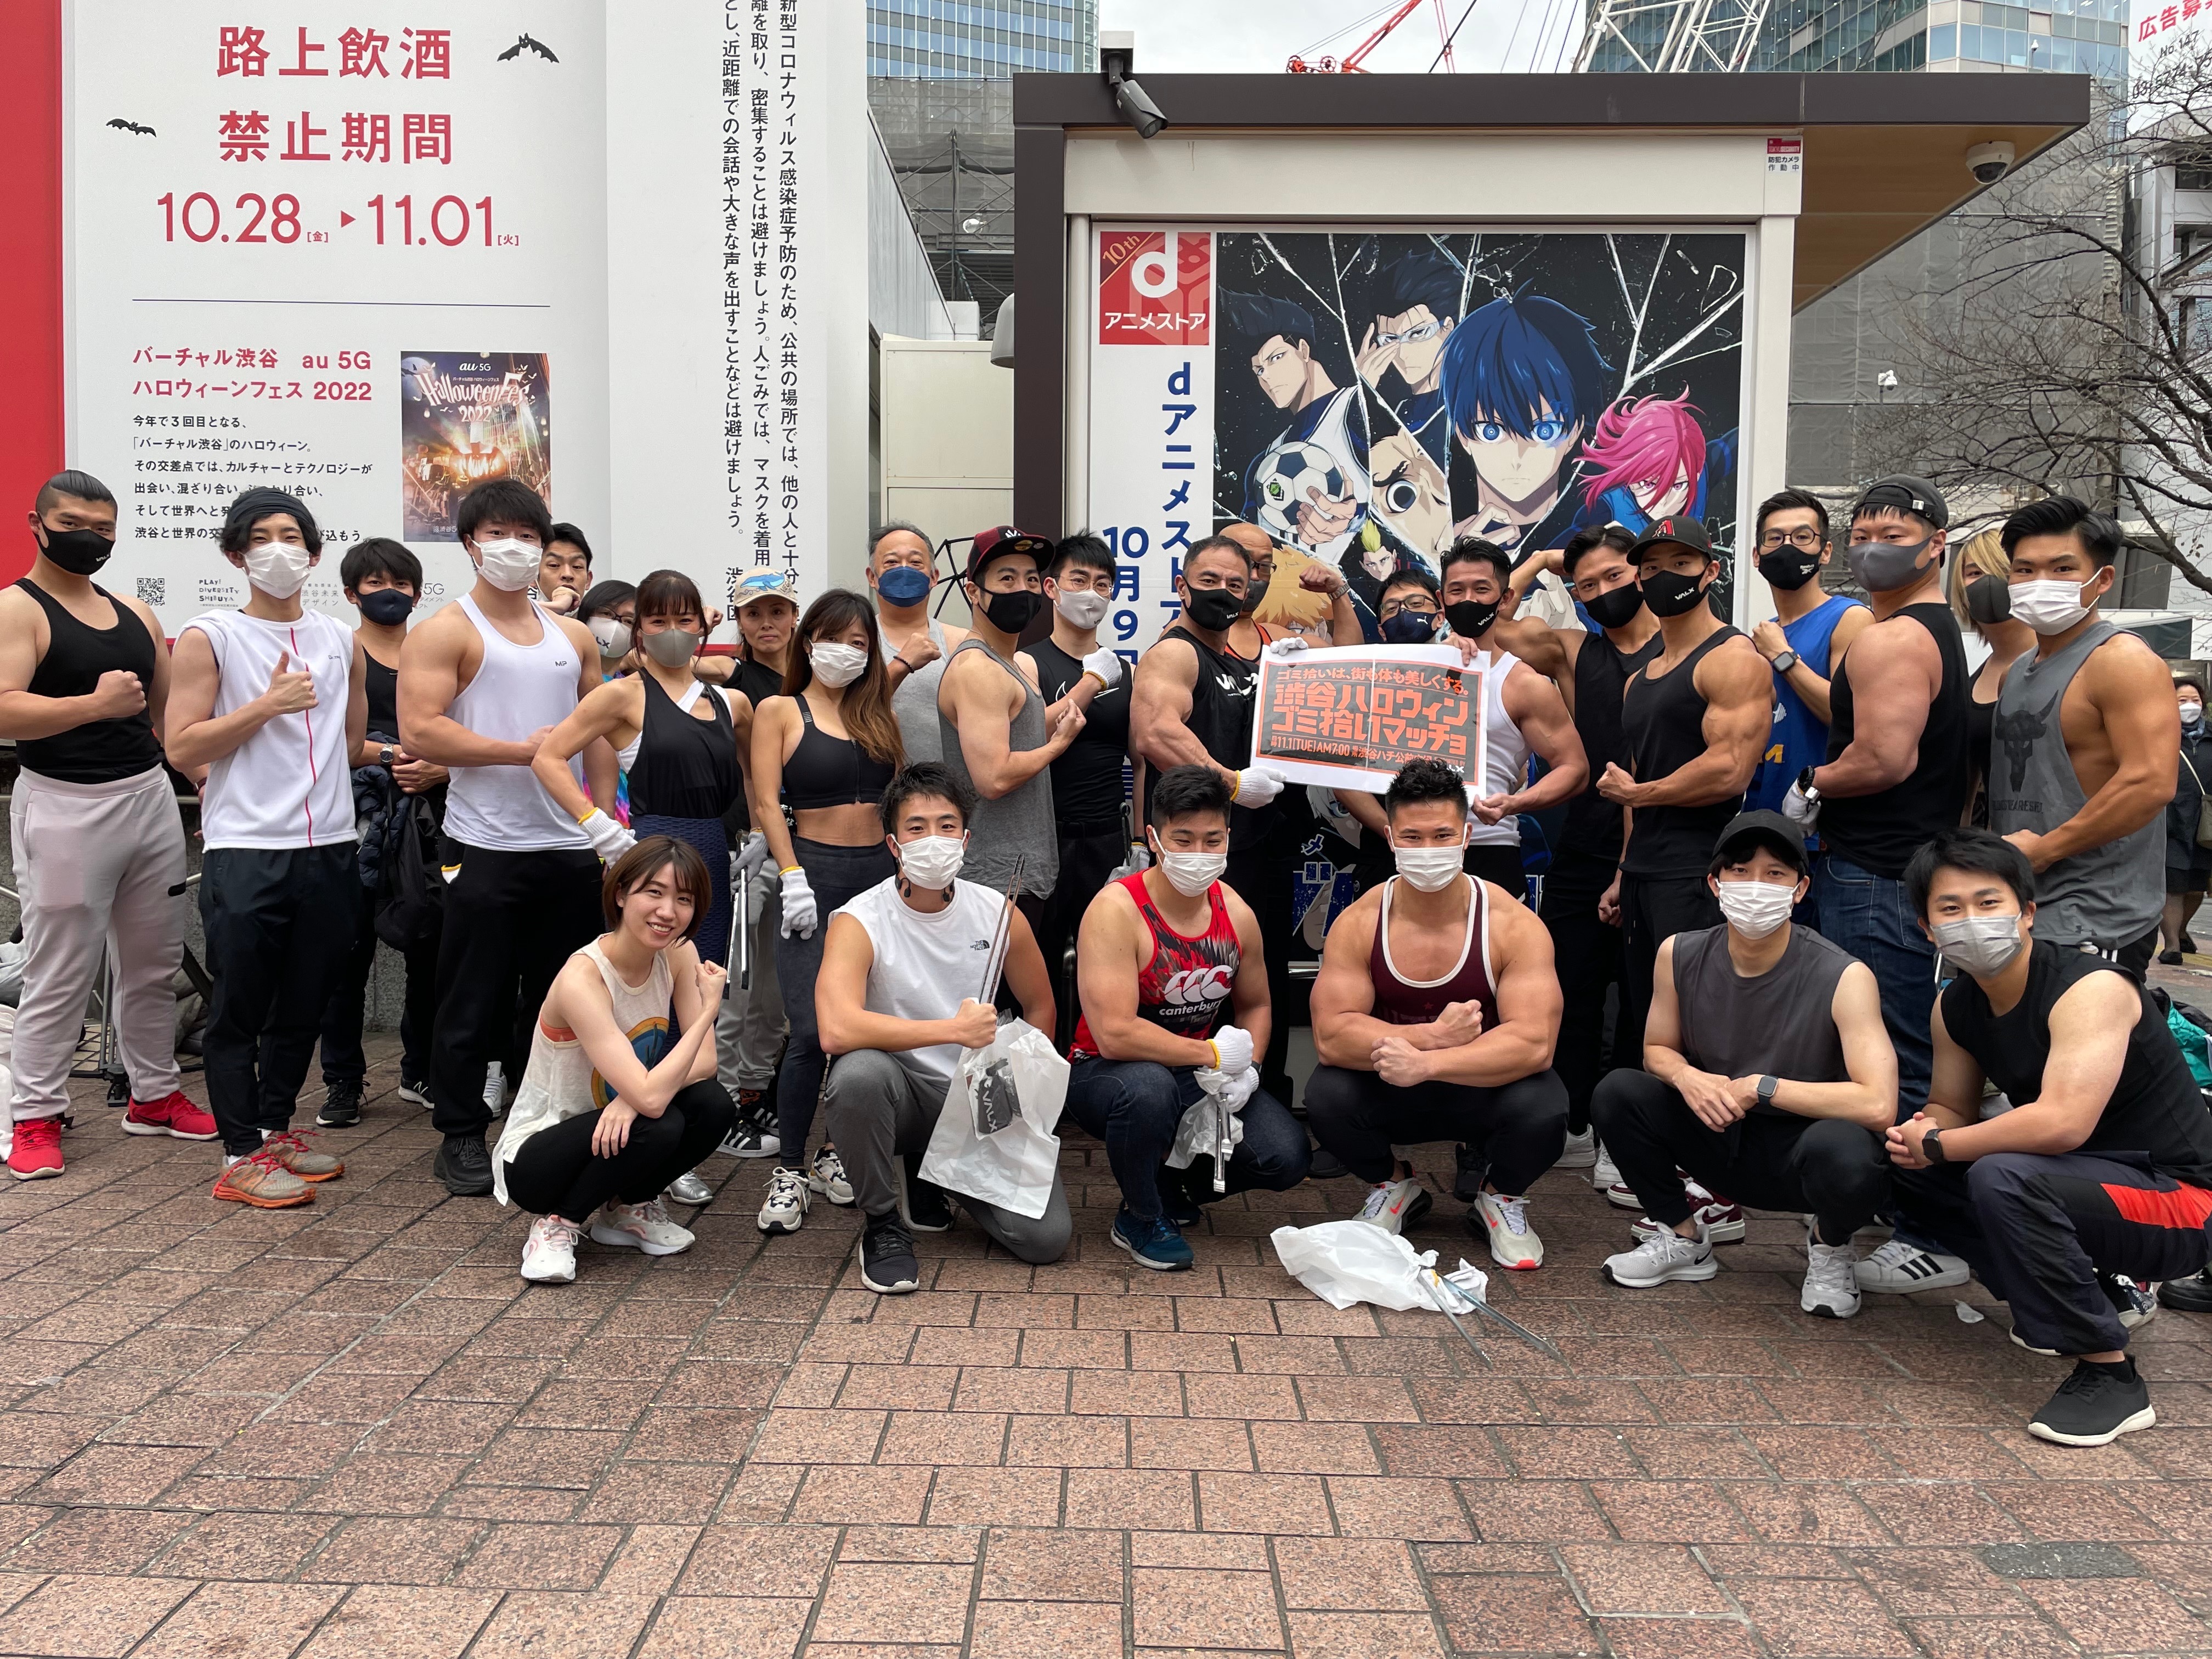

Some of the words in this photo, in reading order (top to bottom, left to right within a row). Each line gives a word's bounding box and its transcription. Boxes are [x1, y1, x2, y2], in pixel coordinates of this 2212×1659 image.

[2139, 0, 2212, 42] 広告募
[217, 26, 451, 80] 路上飲酒
[219, 110, 452, 165] 禁止期間
[1102, 232, 1141, 266] 10th
[1104, 312, 1206, 331] アニメストア
[133, 347, 279, 369] バーチャル渋谷
[302, 354, 329, 369] au
[338, 351, 371, 370] 5G
[459, 362, 478, 371] au
[132, 380, 303, 399] ハロウィーンフェス
[313, 382, 372, 401] 2022
[133, 415, 247, 429] 今年で3回目となる、
[458, 405, 493, 422] 2022
[133, 437, 313, 453] 「バーチャル渋谷」のハロウィーン。
[134, 460, 373, 476] その交差点では、カルチャーとテクノロジーが
[301, 589, 339, 597] 渋谷未来
[1674, 586, 1695, 600] VALX
[1477, 612, 1494, 626] VALX
[594, 635, 611, 649] LX
[1277, 666, 1469, 696] ゴミ拾いは、街も体も美しくする。
[1274, 682, 1469, 726] 渋谷ハロウィン
[1271, 706, 1467, 756] ゴミ拾いマッチョ
[982, 1091, 998, 1133] VALX
